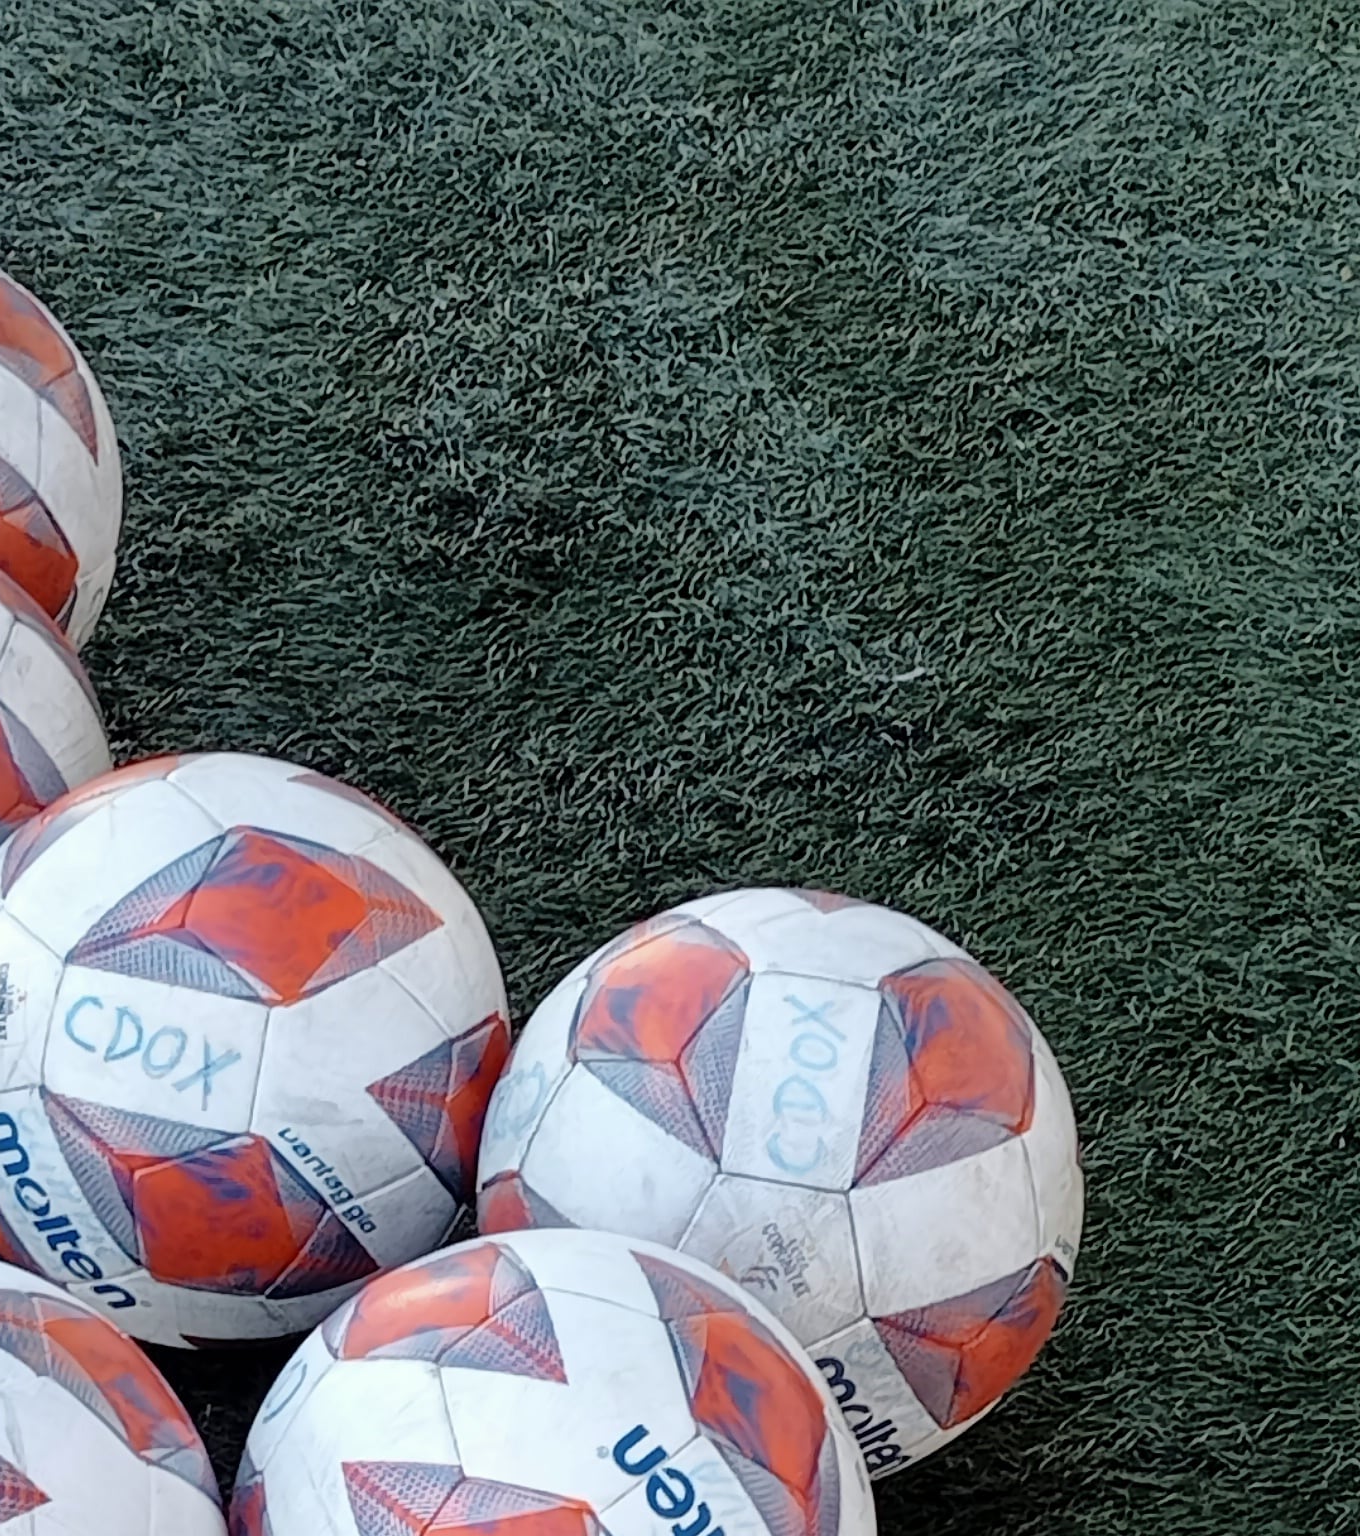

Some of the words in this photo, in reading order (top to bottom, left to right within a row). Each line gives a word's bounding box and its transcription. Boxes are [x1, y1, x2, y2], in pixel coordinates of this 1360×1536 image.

[63, 994, 242, 1111] CDOX
[766, 994, 848, 1177] CDOX
[277, 1127, 379, 1235] vantaggio
